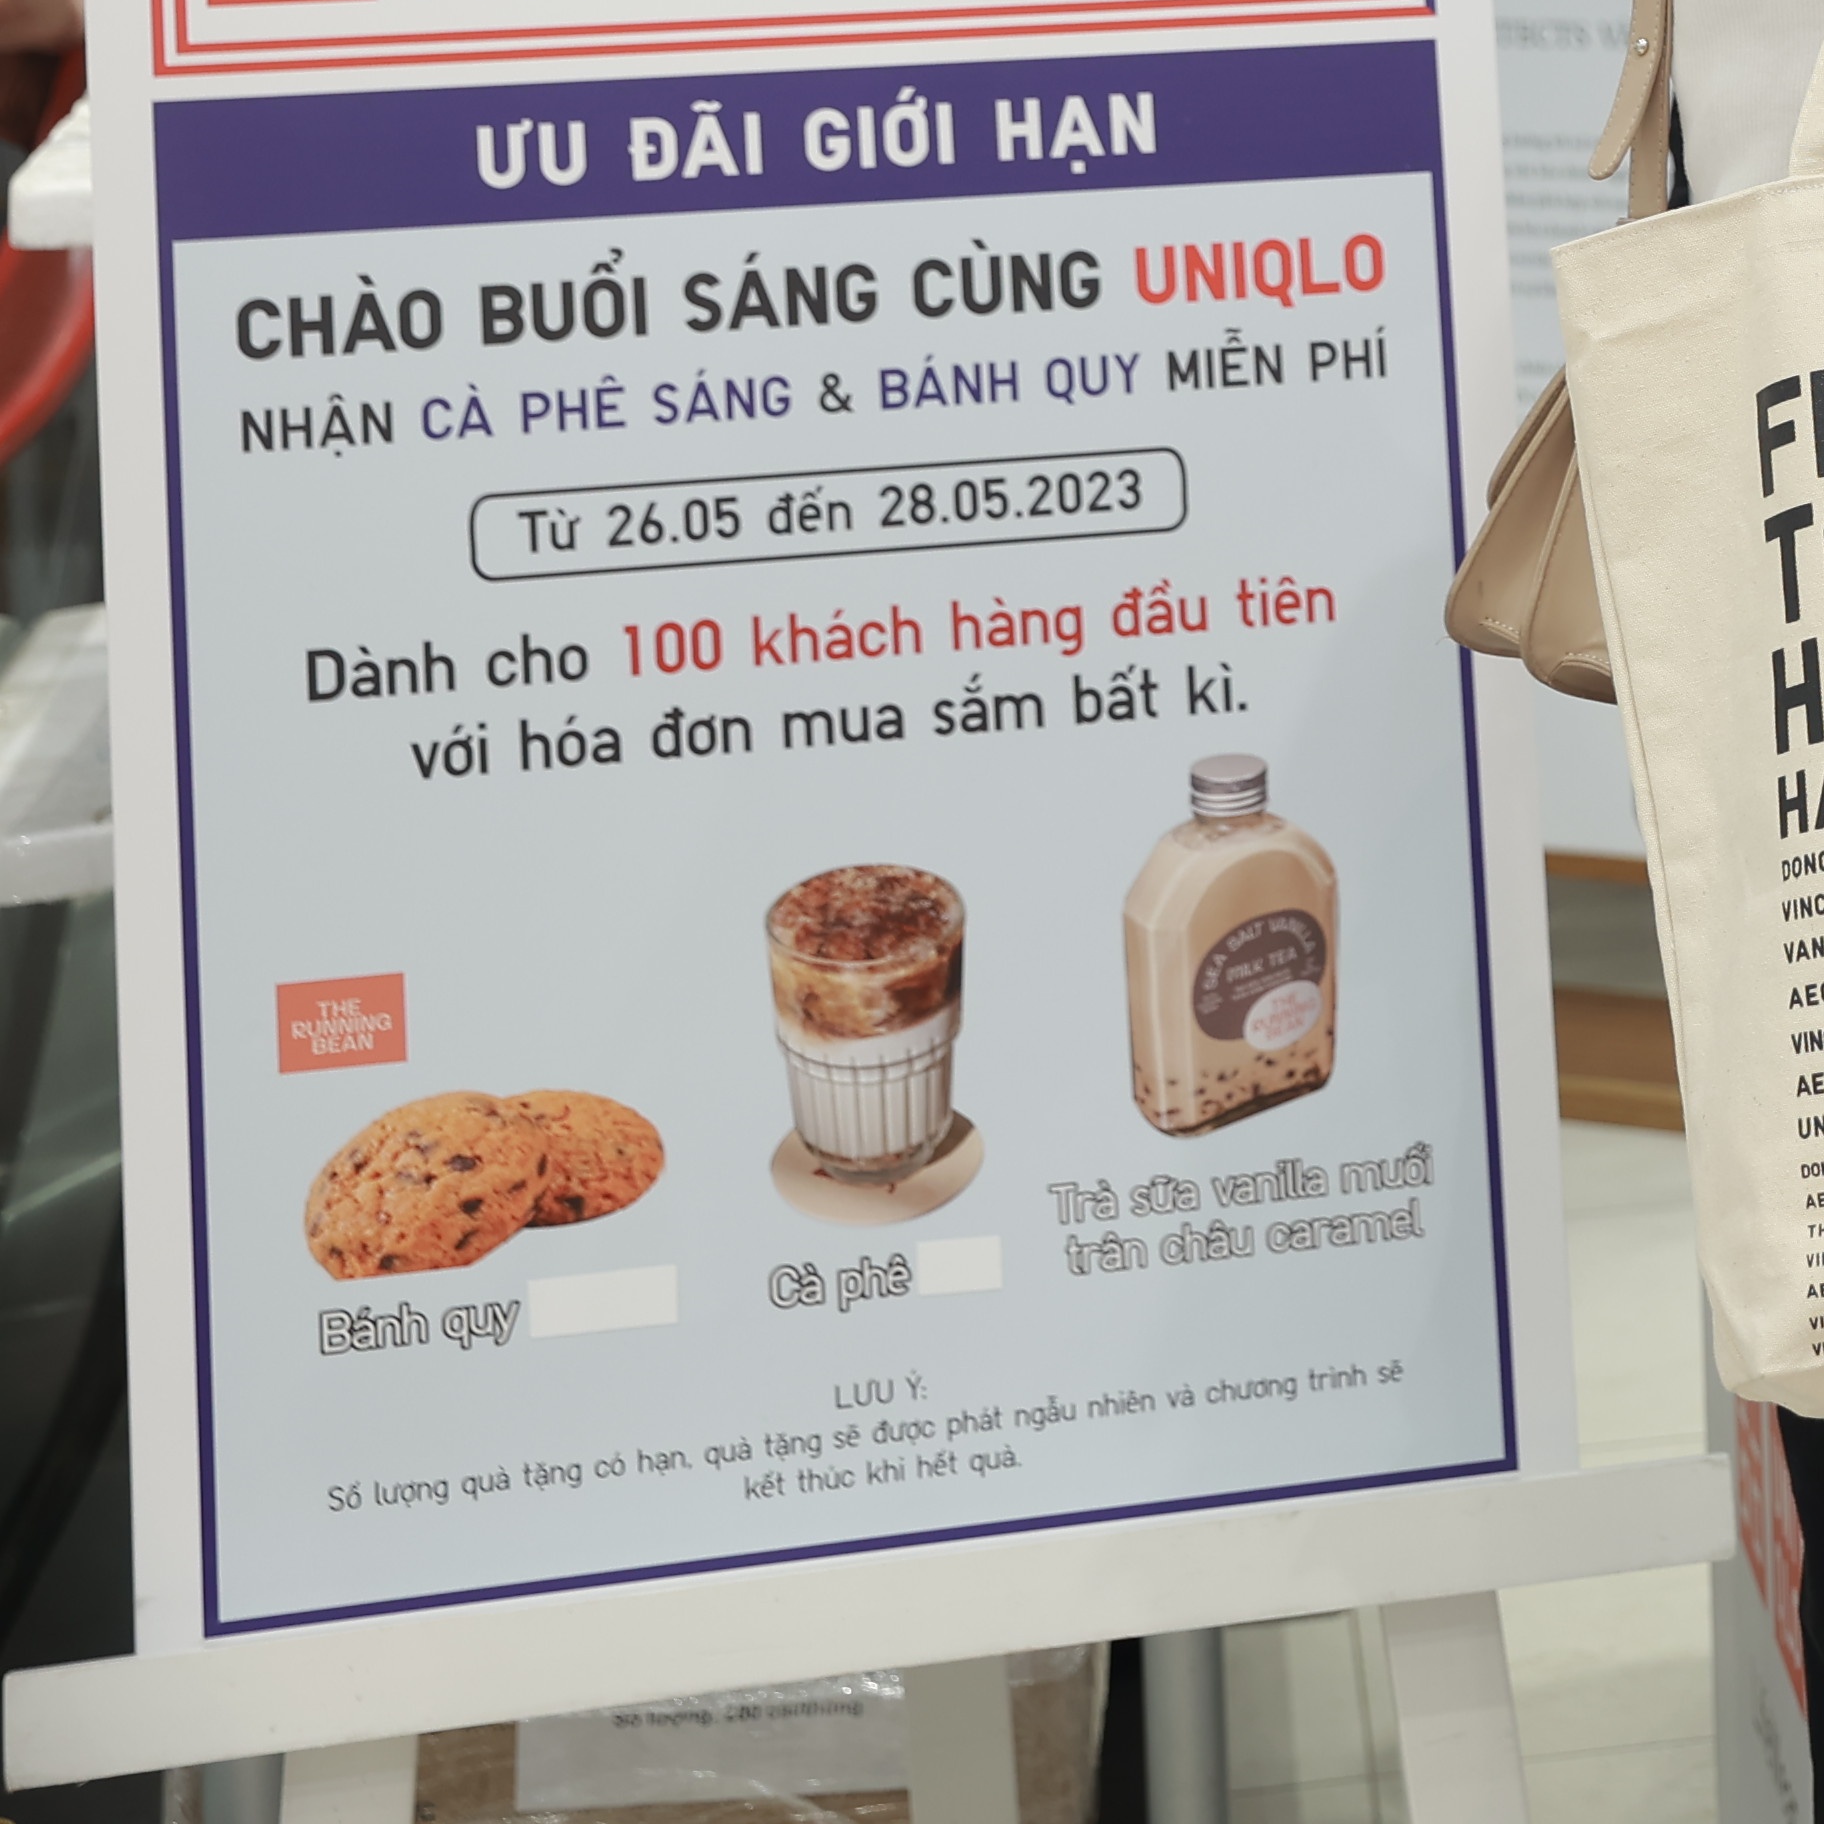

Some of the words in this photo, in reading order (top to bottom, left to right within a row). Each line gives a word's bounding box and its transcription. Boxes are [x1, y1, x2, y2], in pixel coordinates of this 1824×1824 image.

[476, 118, 587, 190] ƯU
[627, 99, 763, 182] ĐÃI
[803, 85, 955, 172] GIỚI
[994, 91, 1157, 175] HẠN
[236, 274, 443, 360] CHÀO
[480, 247, 648, 346] BUỔI
[683, 251, 877, 333] SÁNG
[912, 238, 1100, 318] CÙNG
[1135, 233, 1384, 309] UNIQLO
[241, 393, 393, 457] NHẬN
[422, 383, 493, 441] CÀ
[521, 374, 626, 434] PHÊ
[653, 369, 791, 425] SÁNG
[819, 372, 852, 414] &
[879, 355, 1019, 410] BÁNH
[1045, 353, 1139, 405] QUY
[1167, 328, 1283, 392] MIỄN
[1309, 326, 1386, 382] PHÍ
[517, 508, 581, 554] Từ
[607, 496, 741, 548] 26.05
[768, 486, 852, 535] đến
[879, 468, 1142, 528] 28.05.2023
[306, 641, 456, 702] Dành
[487, 633, 588, 687] cho
[624, 619, 722, 677] 100
[752, 604, 922, 667] khách
[951, 597, 1084, 657] hàng
[1112, 579, 1208, 638] đầu
[1236, 576, 1336, 628] tiên
[410, 722, 489, 780] với
[520, 715, 622, 771] hóa
[652, 706, 752, 759] đơn
[783, 704, 904, 749] mua
[933, 673, 1044, 736] sắm
[1073, 664, 1159, 725] bất
[1187, 662, 1247, 716] kì.
[1202, 953, 1228, 991] SEA
[1226, 919, 1264, 952] SALT
[1268, 947, 1299, 968] TEA
[290, 1013, 394, 1040] RUNNING
[310, 1033, 375, 1056] BEAN
[315, 997, 364, 1020] THE
[1048, 1178, 1117, 1228] Trà
[1130, 1171, 1200, 1219] sữa
[1213, 1162, 1329, 1210] vanilla
[1340, 1140, 1434, 1196] muối
[1064, 1231, 1149, 1278] trân
[1161, 1219, 1254, 1265] châu
[1265, 1198, 1427, 1254] caramel
[769, 1260, 826, 1311] Cà
[836, 1254, 913, 1314] phê
[318, 1300, 430, 1356] Bánh
[440, 1298, 521, 1352] quy
[834, 1378, 895, 1410] LƯU
[904, 1369, 928, 1401] Ý:
[327, 1480, 362, 1513] Số
[374, 1479, 450, 1509] lượng
[460, 1465, 511, 1501] quà
[522, 1462, 583, 1492] tặng
[593, 1452, 626, 1479] có
[636, 1448, 693, 1477] hạn,
[703, 1436, 753, 1471] quà
[764, 1433, 823, 1462] tặng
[832, 1423, 861, 1450] sẽ
[871, 1419, 936, 1446] được
[946, 1406, 1003, 1443] phát
[1013, 1394, 1077, 1433] ngẫu
[1087, 1389, 1157, 1419] nhiên
[1165, 1383, 1196, 1409] và
[1205, 1376, 1298, 1405] chương
[1307, 1363, 1368, 1392] trình
[1377, 1359, 1405, 1385] sẽ
[743, 1470, 786, 1501] kết
[797, 1466, 856, 1494] thúc
[866, 1456, 906, 1485] khi
[916, 1450, 958, 1479] hết
[968, 1444, 1023, 1478] quà.
